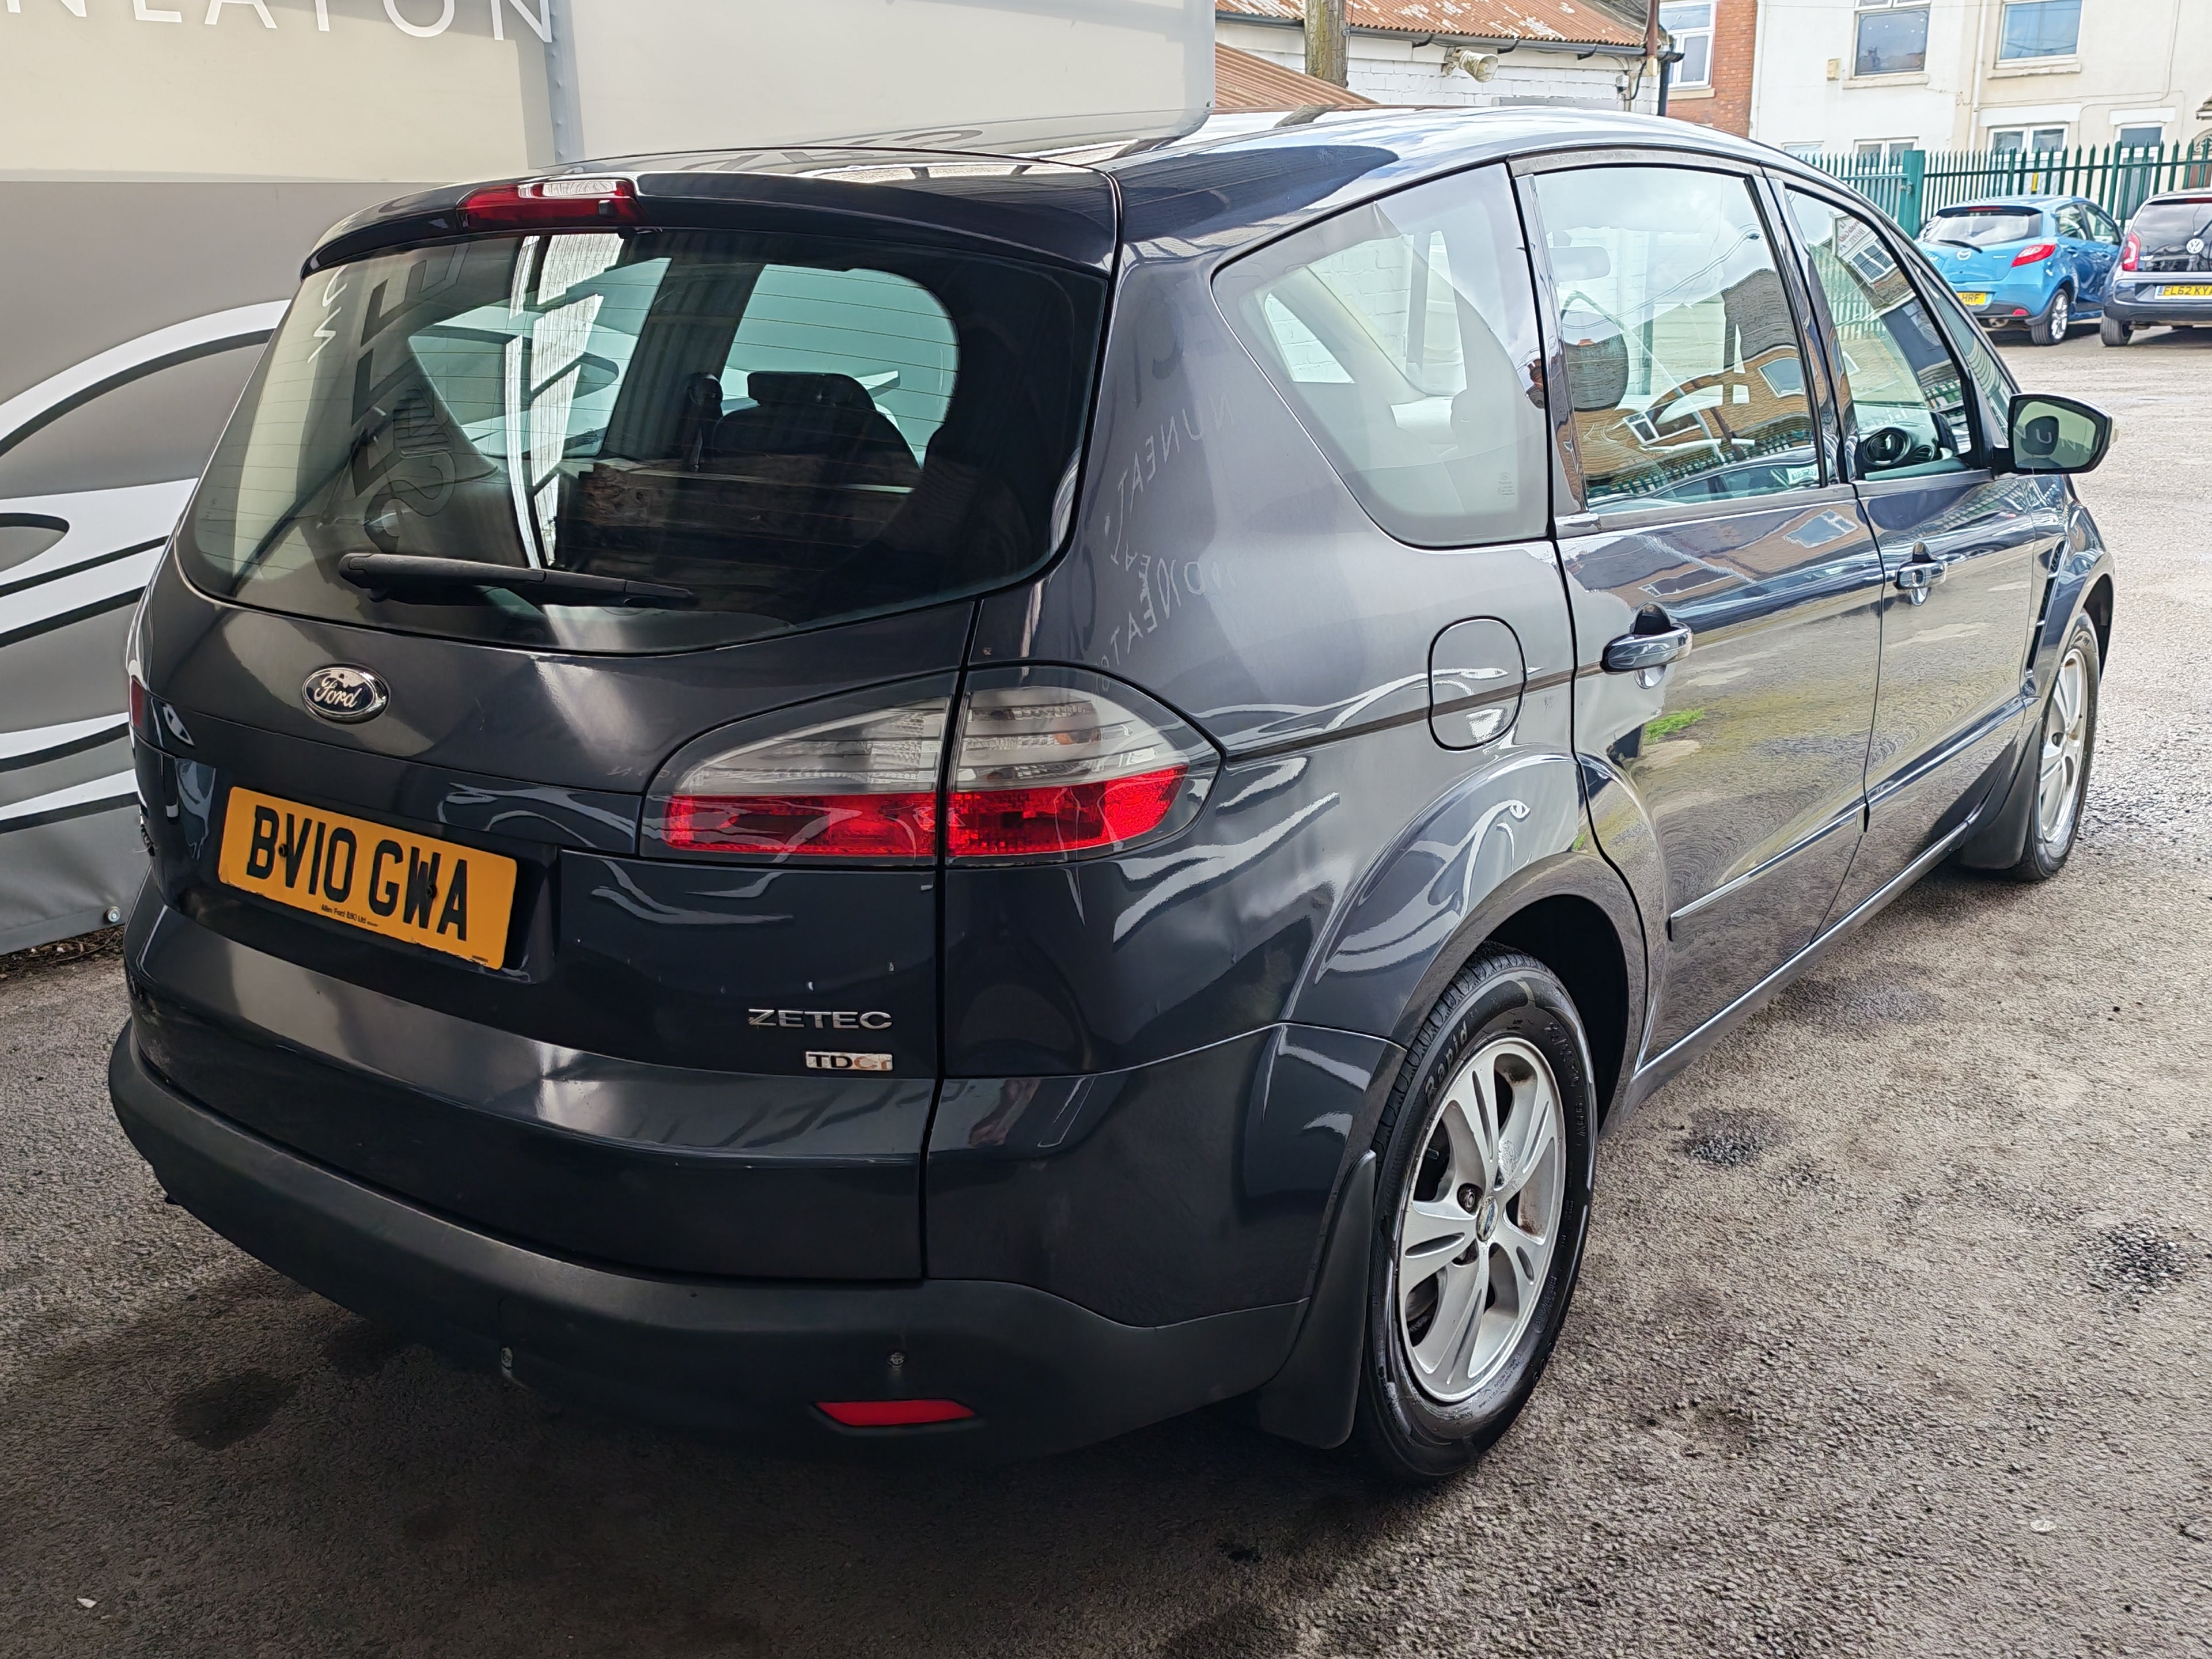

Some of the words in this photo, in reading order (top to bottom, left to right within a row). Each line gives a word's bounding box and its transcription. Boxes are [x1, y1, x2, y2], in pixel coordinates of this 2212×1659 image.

[2163, 286, 2192, 296] FL62
[315, 675, 361, 708] Ford
[246, 805, 357, 903] BV10
[369, 838, 468, 942] GWA
[334, 908, 346, 918] Ford
[358, 915, 366, 923] Ltd
[748, 1008, 893, 1030] ZETEC
[1425, 1020, 1468, 1107] Rapid
